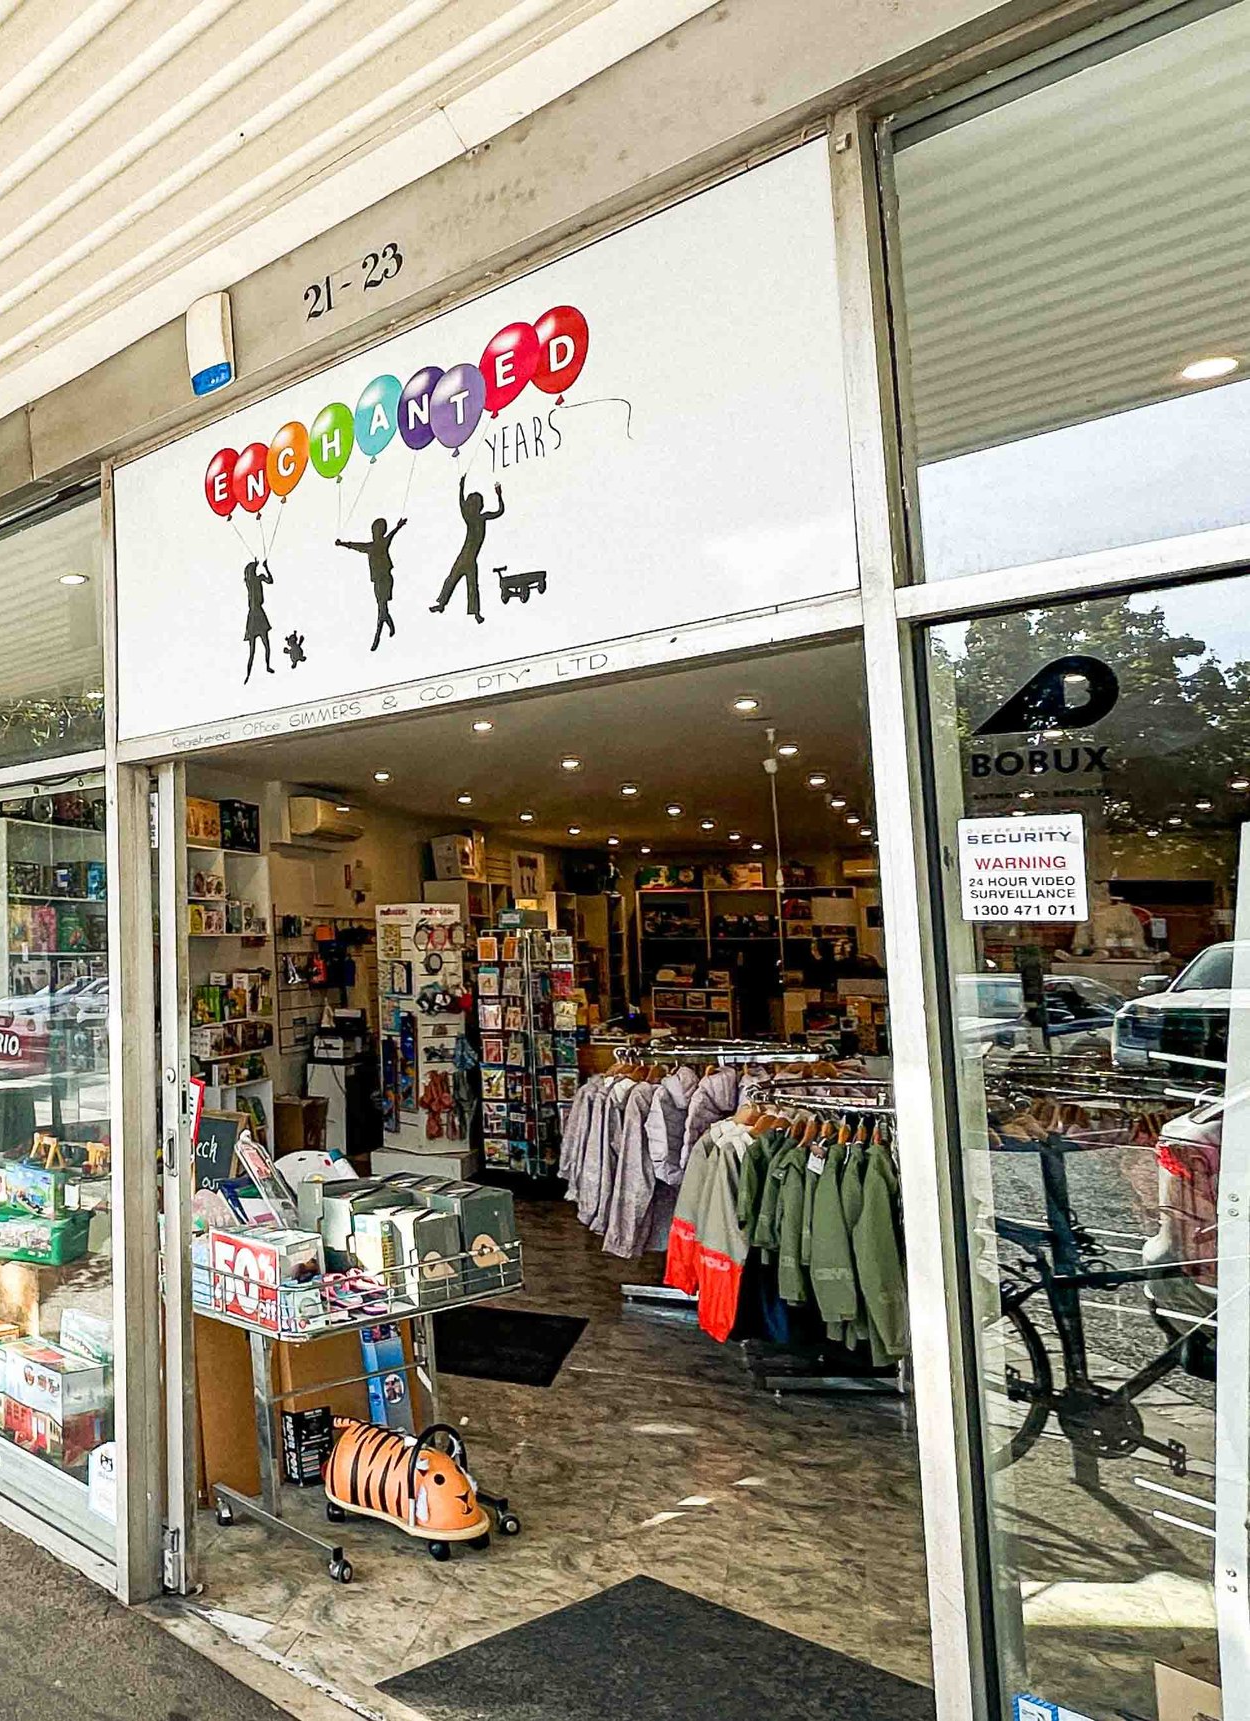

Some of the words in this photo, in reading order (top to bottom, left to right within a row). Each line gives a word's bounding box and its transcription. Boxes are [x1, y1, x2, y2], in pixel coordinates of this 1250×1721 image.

[212, 332, 576, 504] ENCHANTED
[484, 408, 564, 473] YEARS
[381, 695, 398, 711] &
[419, 684, 455, 702] CO
[556, 653, 608, 677] LTD
[970, 746, 1111, 778] BOBUX
[967, 831, 1072, 845] SECURITY
[974, 856, 1067, 870] WARNING
[969, 879, 984, 888] 24
[988, 877, 1028, 887] HOUR
[1031, 876, 1076, 887] VIDEO
[970, 889, 1076, 899] SURVEILLANCE
[974, 905, 1009, 916] 1300
[1014, 905, 1041, 916] 471
[1048, 905, 1075, 916] 071
